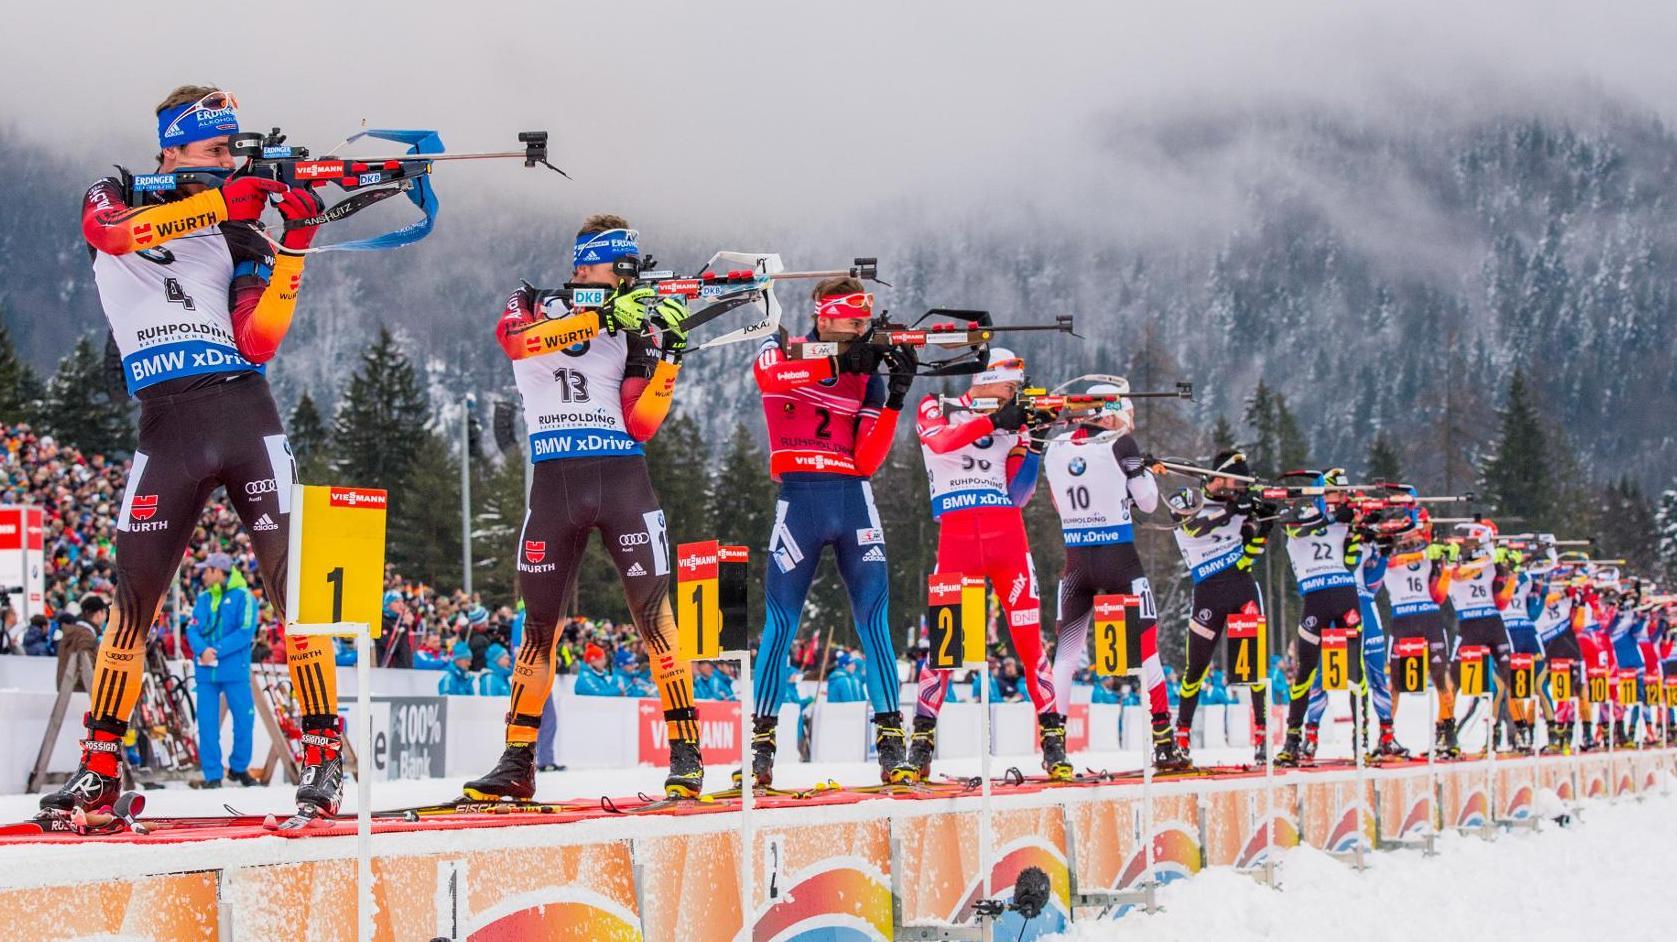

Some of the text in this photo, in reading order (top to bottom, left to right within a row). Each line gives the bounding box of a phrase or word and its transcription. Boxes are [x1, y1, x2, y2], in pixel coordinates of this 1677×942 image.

[135, 174, 175, 186] ERDINGER
[296, 164, 343, 177] VIESSMANN
[361, 174, 381, 186] DKB
[164, 277, 196, 312] 4
[575, 292, 602, 304] DKB
[703, 287, 721, 296] DKB
[131, 348, 263, 382] BMW xDriv
[553, 367, 592, 404] 13
[538, 412, 617, 426] RUHPOLDING
[816, 409, 832, 437] 2
[534, 434, 635, 456] BMW xDrive
[331, 491, 386, 506] VIESSMANN
[942, 492, 1013, 510] BMW xDriv
[1066, 485, 1090, 511] 10
[252, 522, 279, 532] adidas
[1064, 530, 1120, 544] MW xDrive
[679, 554, 718, 572] VIESSMANN
[1311, 542, 1333, 560] 22
[1199, 558, 1225, 578] BMW
[326, 566, 345, 624] 1
[1008, 572, 1028, 607] swix
[1302, 577, 1326, 591] BMW
[1407, 577, 1423, 593] 16
[1469, 584, 1487, 598] 26
[1140, 590, 1156, 617] 10
[692, 584, 704, 655] 1
[1013, 611, 1038, 624] DNB
[937, 606, 954, 666] 2
[1104, 623, 1118, 672] 3
[1234, 638, 1251, 682] 4
[1329, 650, 1340, 688] 5
[1405, 656, 1418, 692] 6
[1467, 664, 1477, 693] 7
[1515, 669, 1527, 699] 8
[1556, 674, 1565, 699] 9
[1589, 677, 1605, 703] 10
[1622, 681, 1633, 705] 11
[398, 703, 441, 745] 100%
[399, 747, 430, 780] Bank
